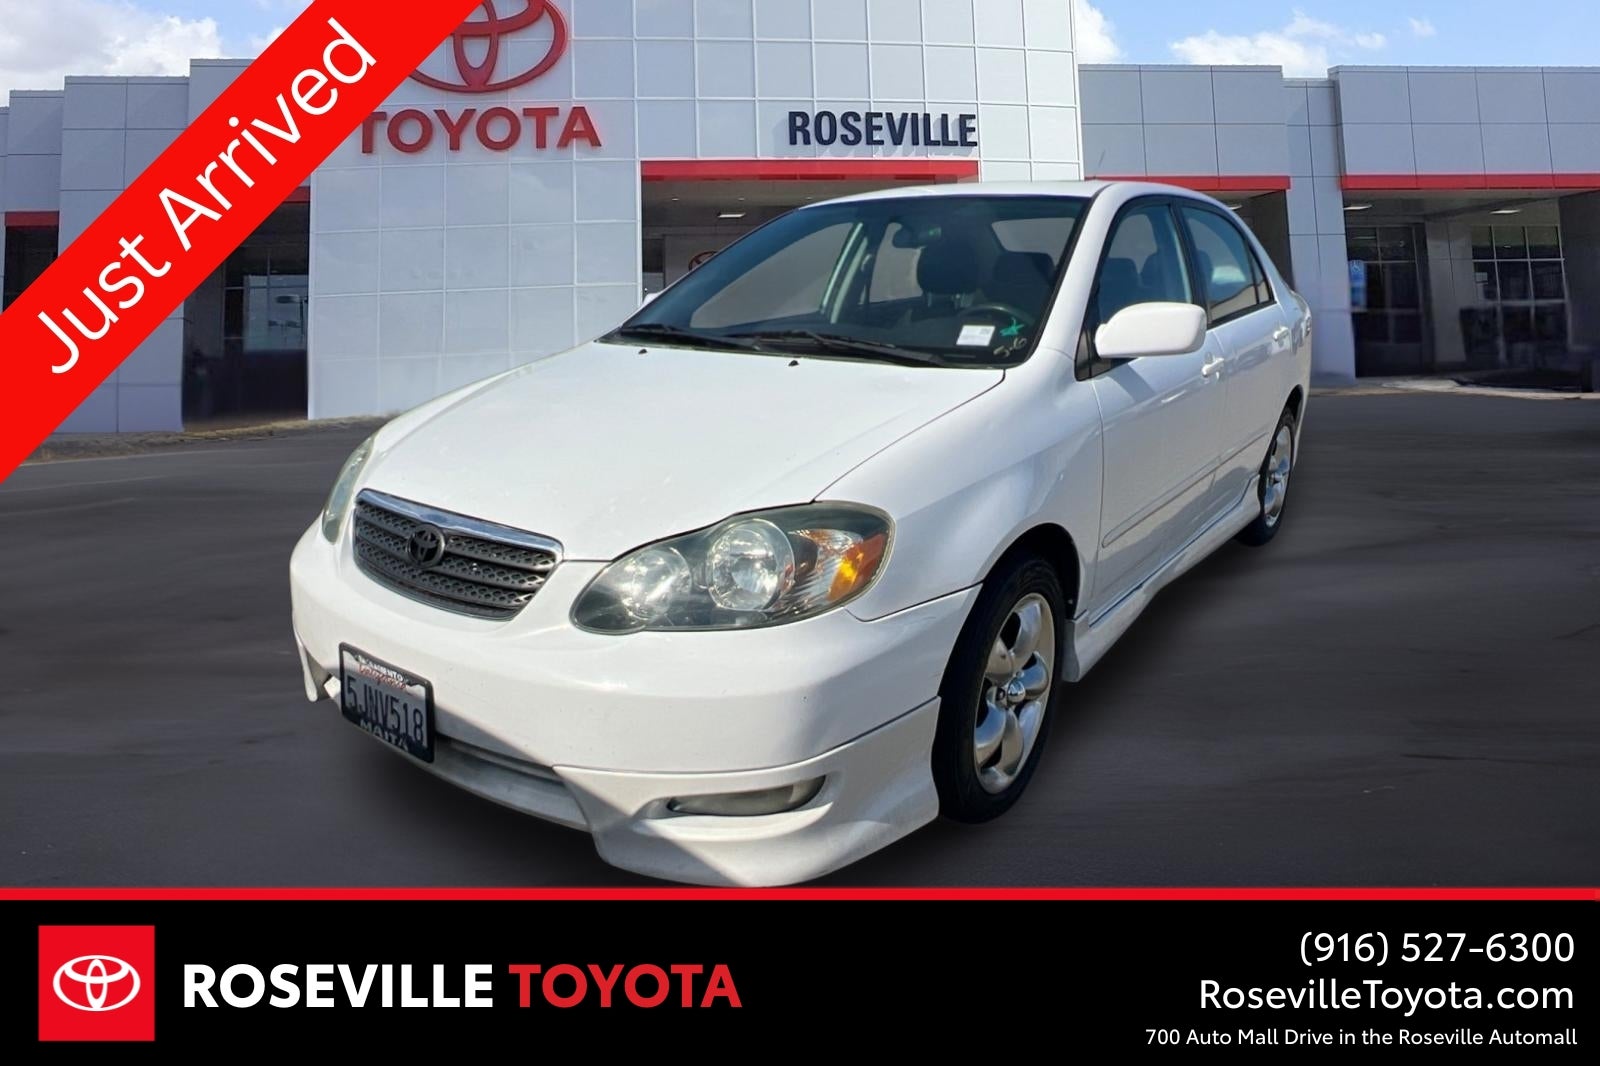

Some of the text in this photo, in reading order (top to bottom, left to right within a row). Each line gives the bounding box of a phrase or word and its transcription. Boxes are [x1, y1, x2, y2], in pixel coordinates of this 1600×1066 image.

[360, 106, 602, 154] TOYOTA
[788, 110, 978, 147] ROSEVILLE
[343, 675, 424, 746] 5JNV518
